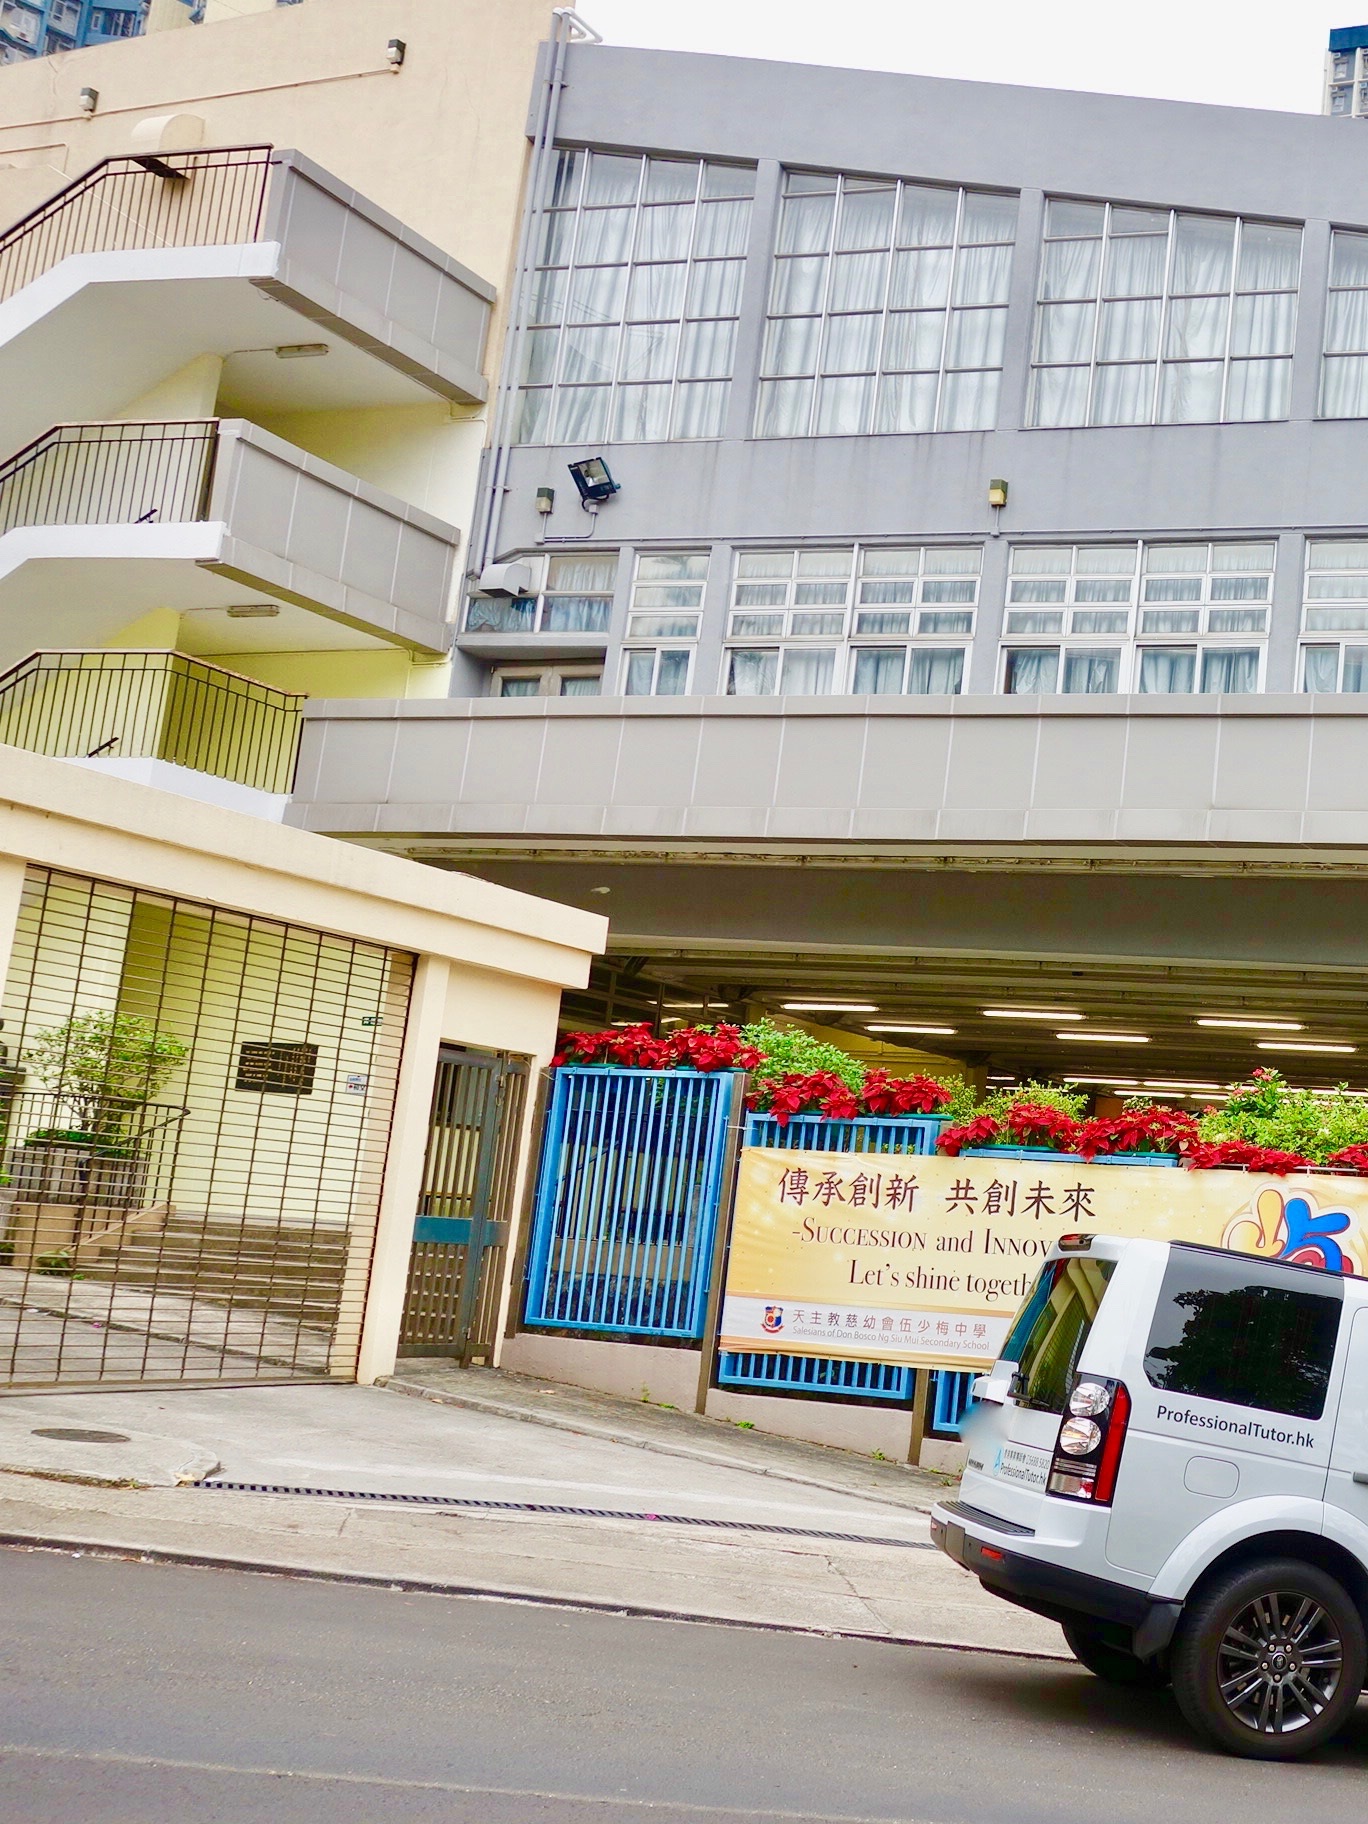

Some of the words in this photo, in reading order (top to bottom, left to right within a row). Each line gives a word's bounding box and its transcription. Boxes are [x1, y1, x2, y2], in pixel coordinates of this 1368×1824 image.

[778, 1167, 920, 1213] 傳承創新
[945, 1178, 1096, 1222] 共創未來
[936, 1230, 973, 1253] and
[984, 1228, 1053, 1258] INNOV
[905, 1266, 960, 1290] shine
[966, 1273, 1032, 1300] togeth
[792, 1309, 987, 1339] 天主教慈幼會伍少梅中學
[792, 1325, 826, 1337] Salesians
[827, 1328, 835, 1338] of
[836, 1329, 853, 1339] Don
[854, 1331, 877, 1341] Bosco
[878, 1333, 889, 1344] Ng
[891, 1334, 903, 1343] Siu
[903, 1335, 919, 1345] Mui
[920, 1336, 961, 1350] Secondary
[962, 1340, 990, 1351] School
[1157, 1405, 1315, 1449] ProfessionalTutor.hk
